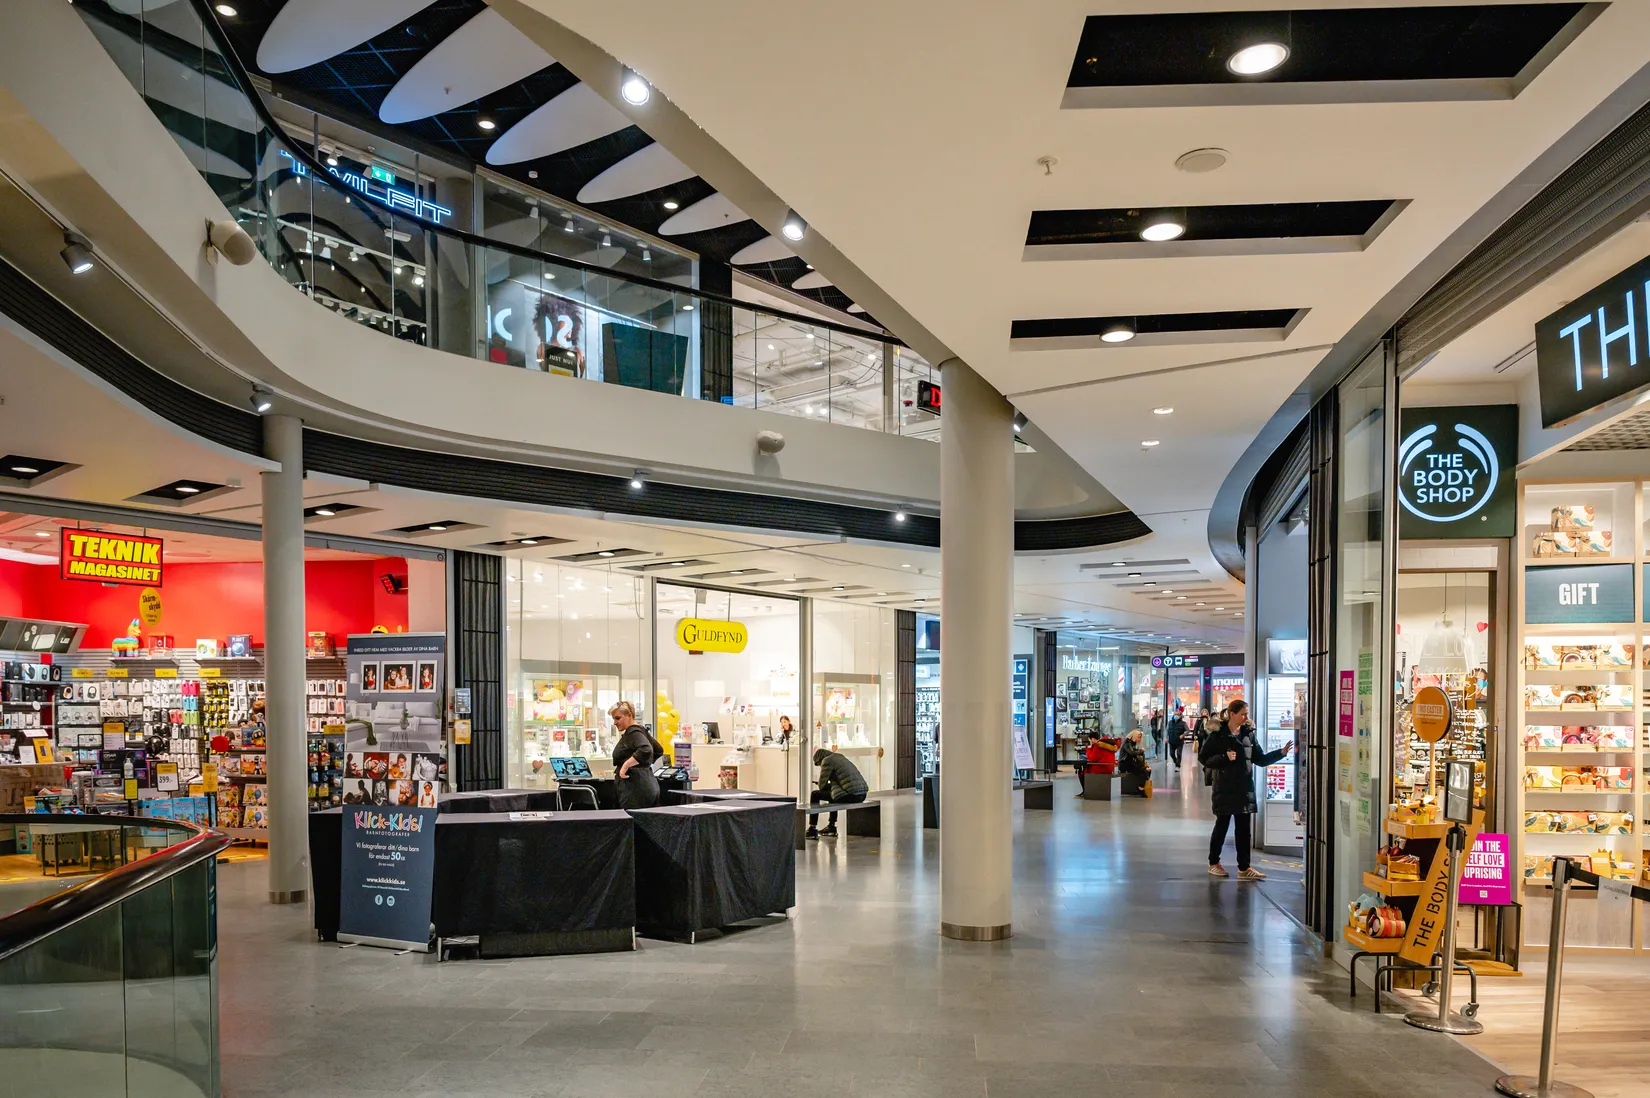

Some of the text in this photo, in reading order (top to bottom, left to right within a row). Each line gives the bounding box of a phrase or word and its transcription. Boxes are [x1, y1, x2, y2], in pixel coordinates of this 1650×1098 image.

[1426, 454, 1463, 468] THE
[1414, 469, 1478, 486] BODY
[1416, 487, 1474, 503] SHOP
[70, 534, 161, 564] TEKNIK
[70, 560, 161, 582] MAGASINET
[1559, 583, 1599, 605] GIFT
[683, 624, 742, 644] GULDFYND
[354, 811, 423, 832] Klick-Kids!
[1485, 841, 1501, 852] THE
[1468, 854, 1502, 865] ELF LOVE
[1464, 867, 1502, 879] UPRISING
[1413, 871, 1449, 947] THE BODY
